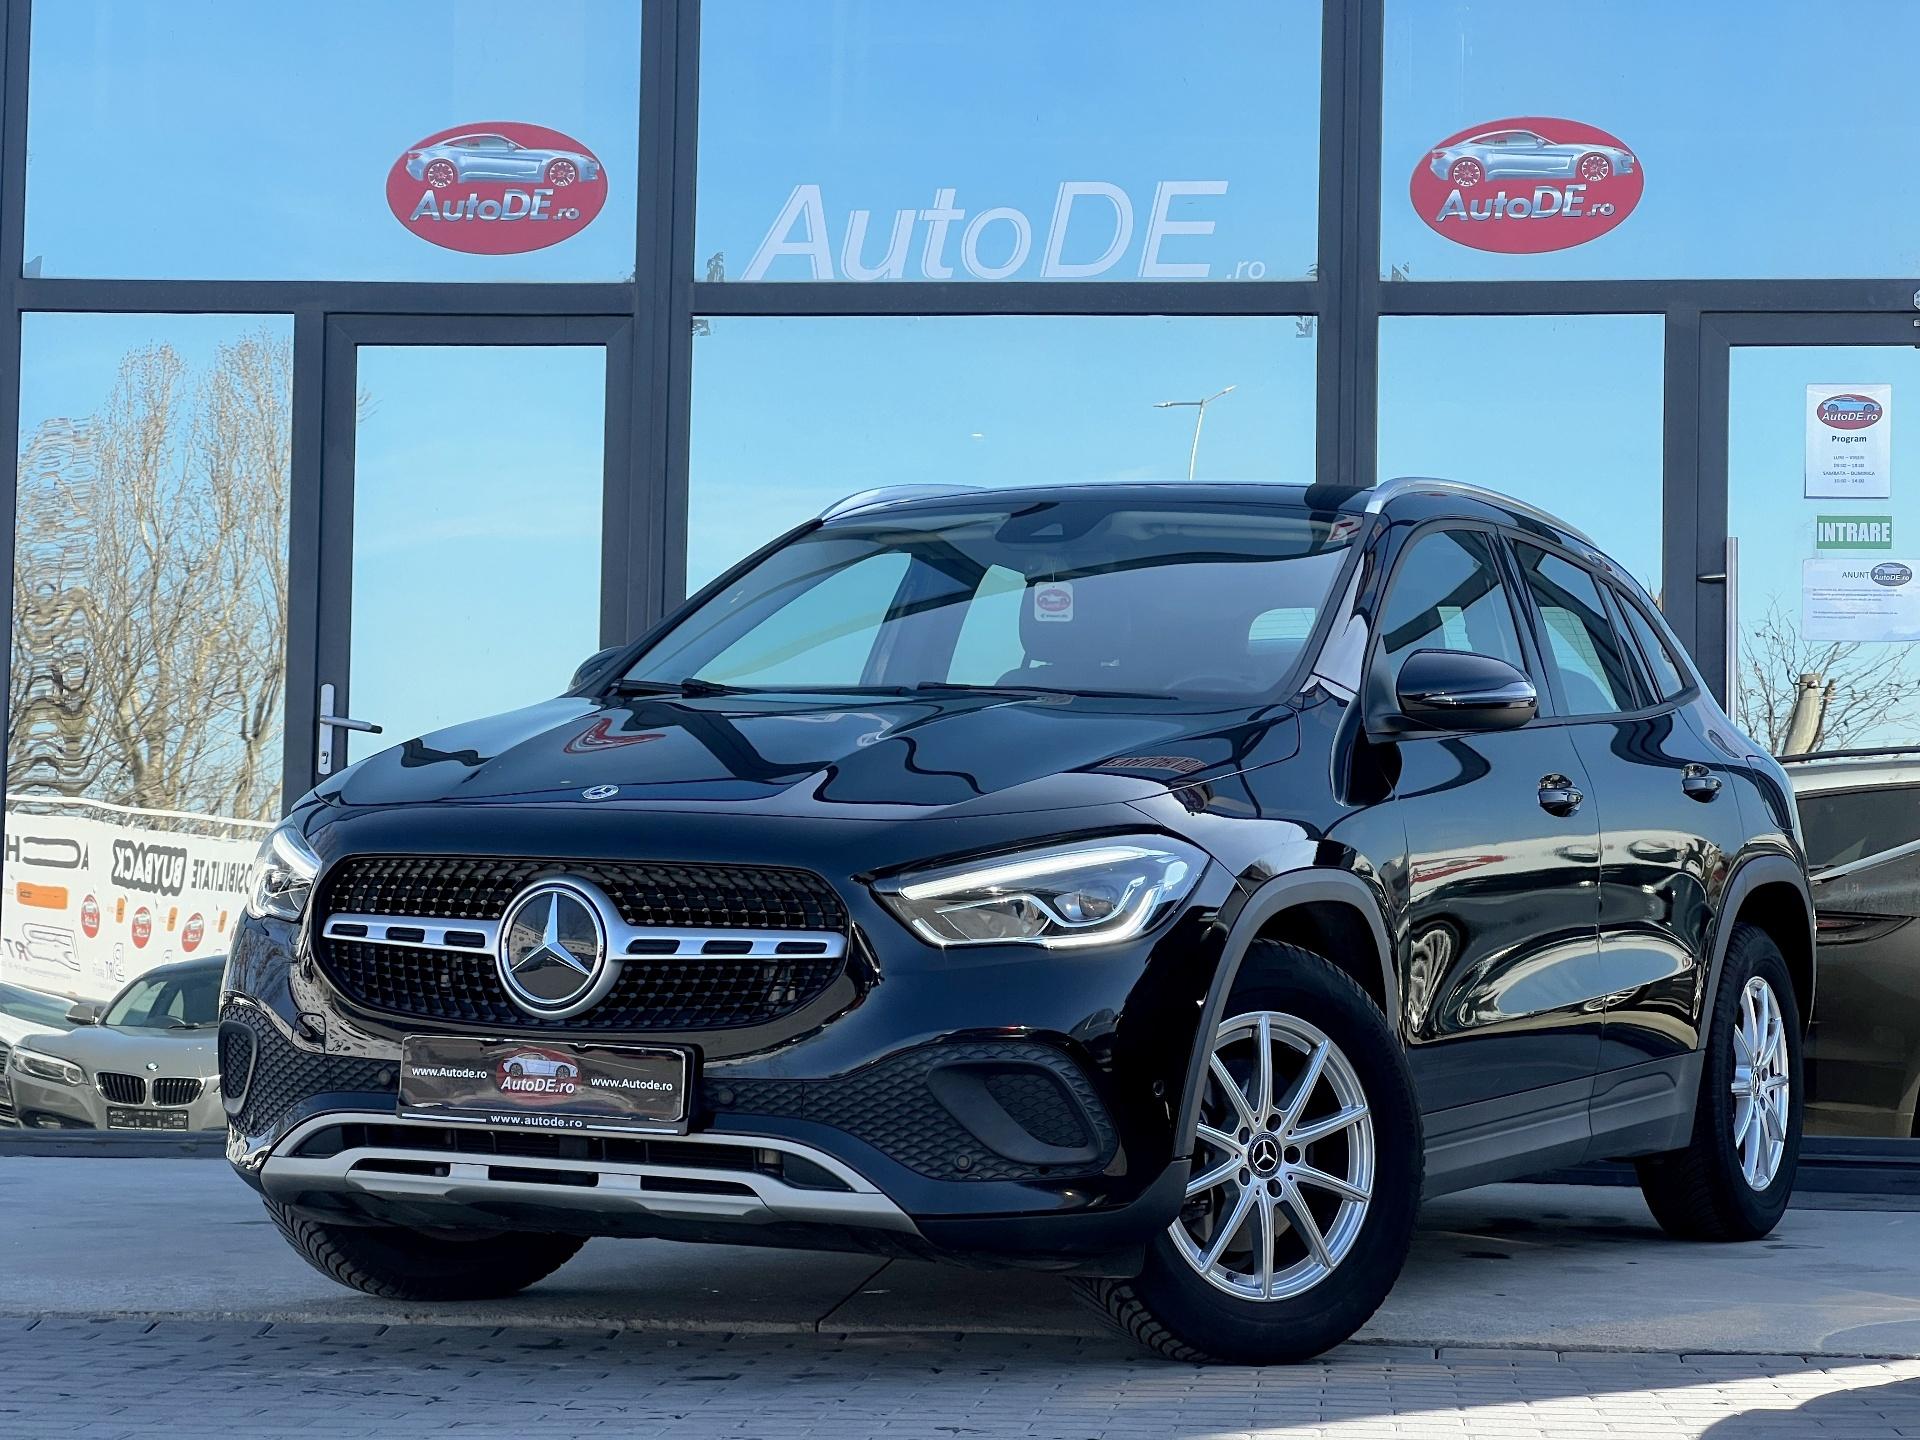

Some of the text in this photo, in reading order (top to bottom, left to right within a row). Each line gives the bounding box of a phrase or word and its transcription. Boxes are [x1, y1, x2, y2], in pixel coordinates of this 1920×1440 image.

[1822, 412, 1878, 421] AutoDE.ro
[1831, 435, 1867, 443] Program
[1818, 523, 1891, 542] INTRARE
[411, 1066, 673, 1094] www.Autode.ro AutoDE.ro www.Autode.ro
[490, 1114, 583, 1128] www.autode.ro
